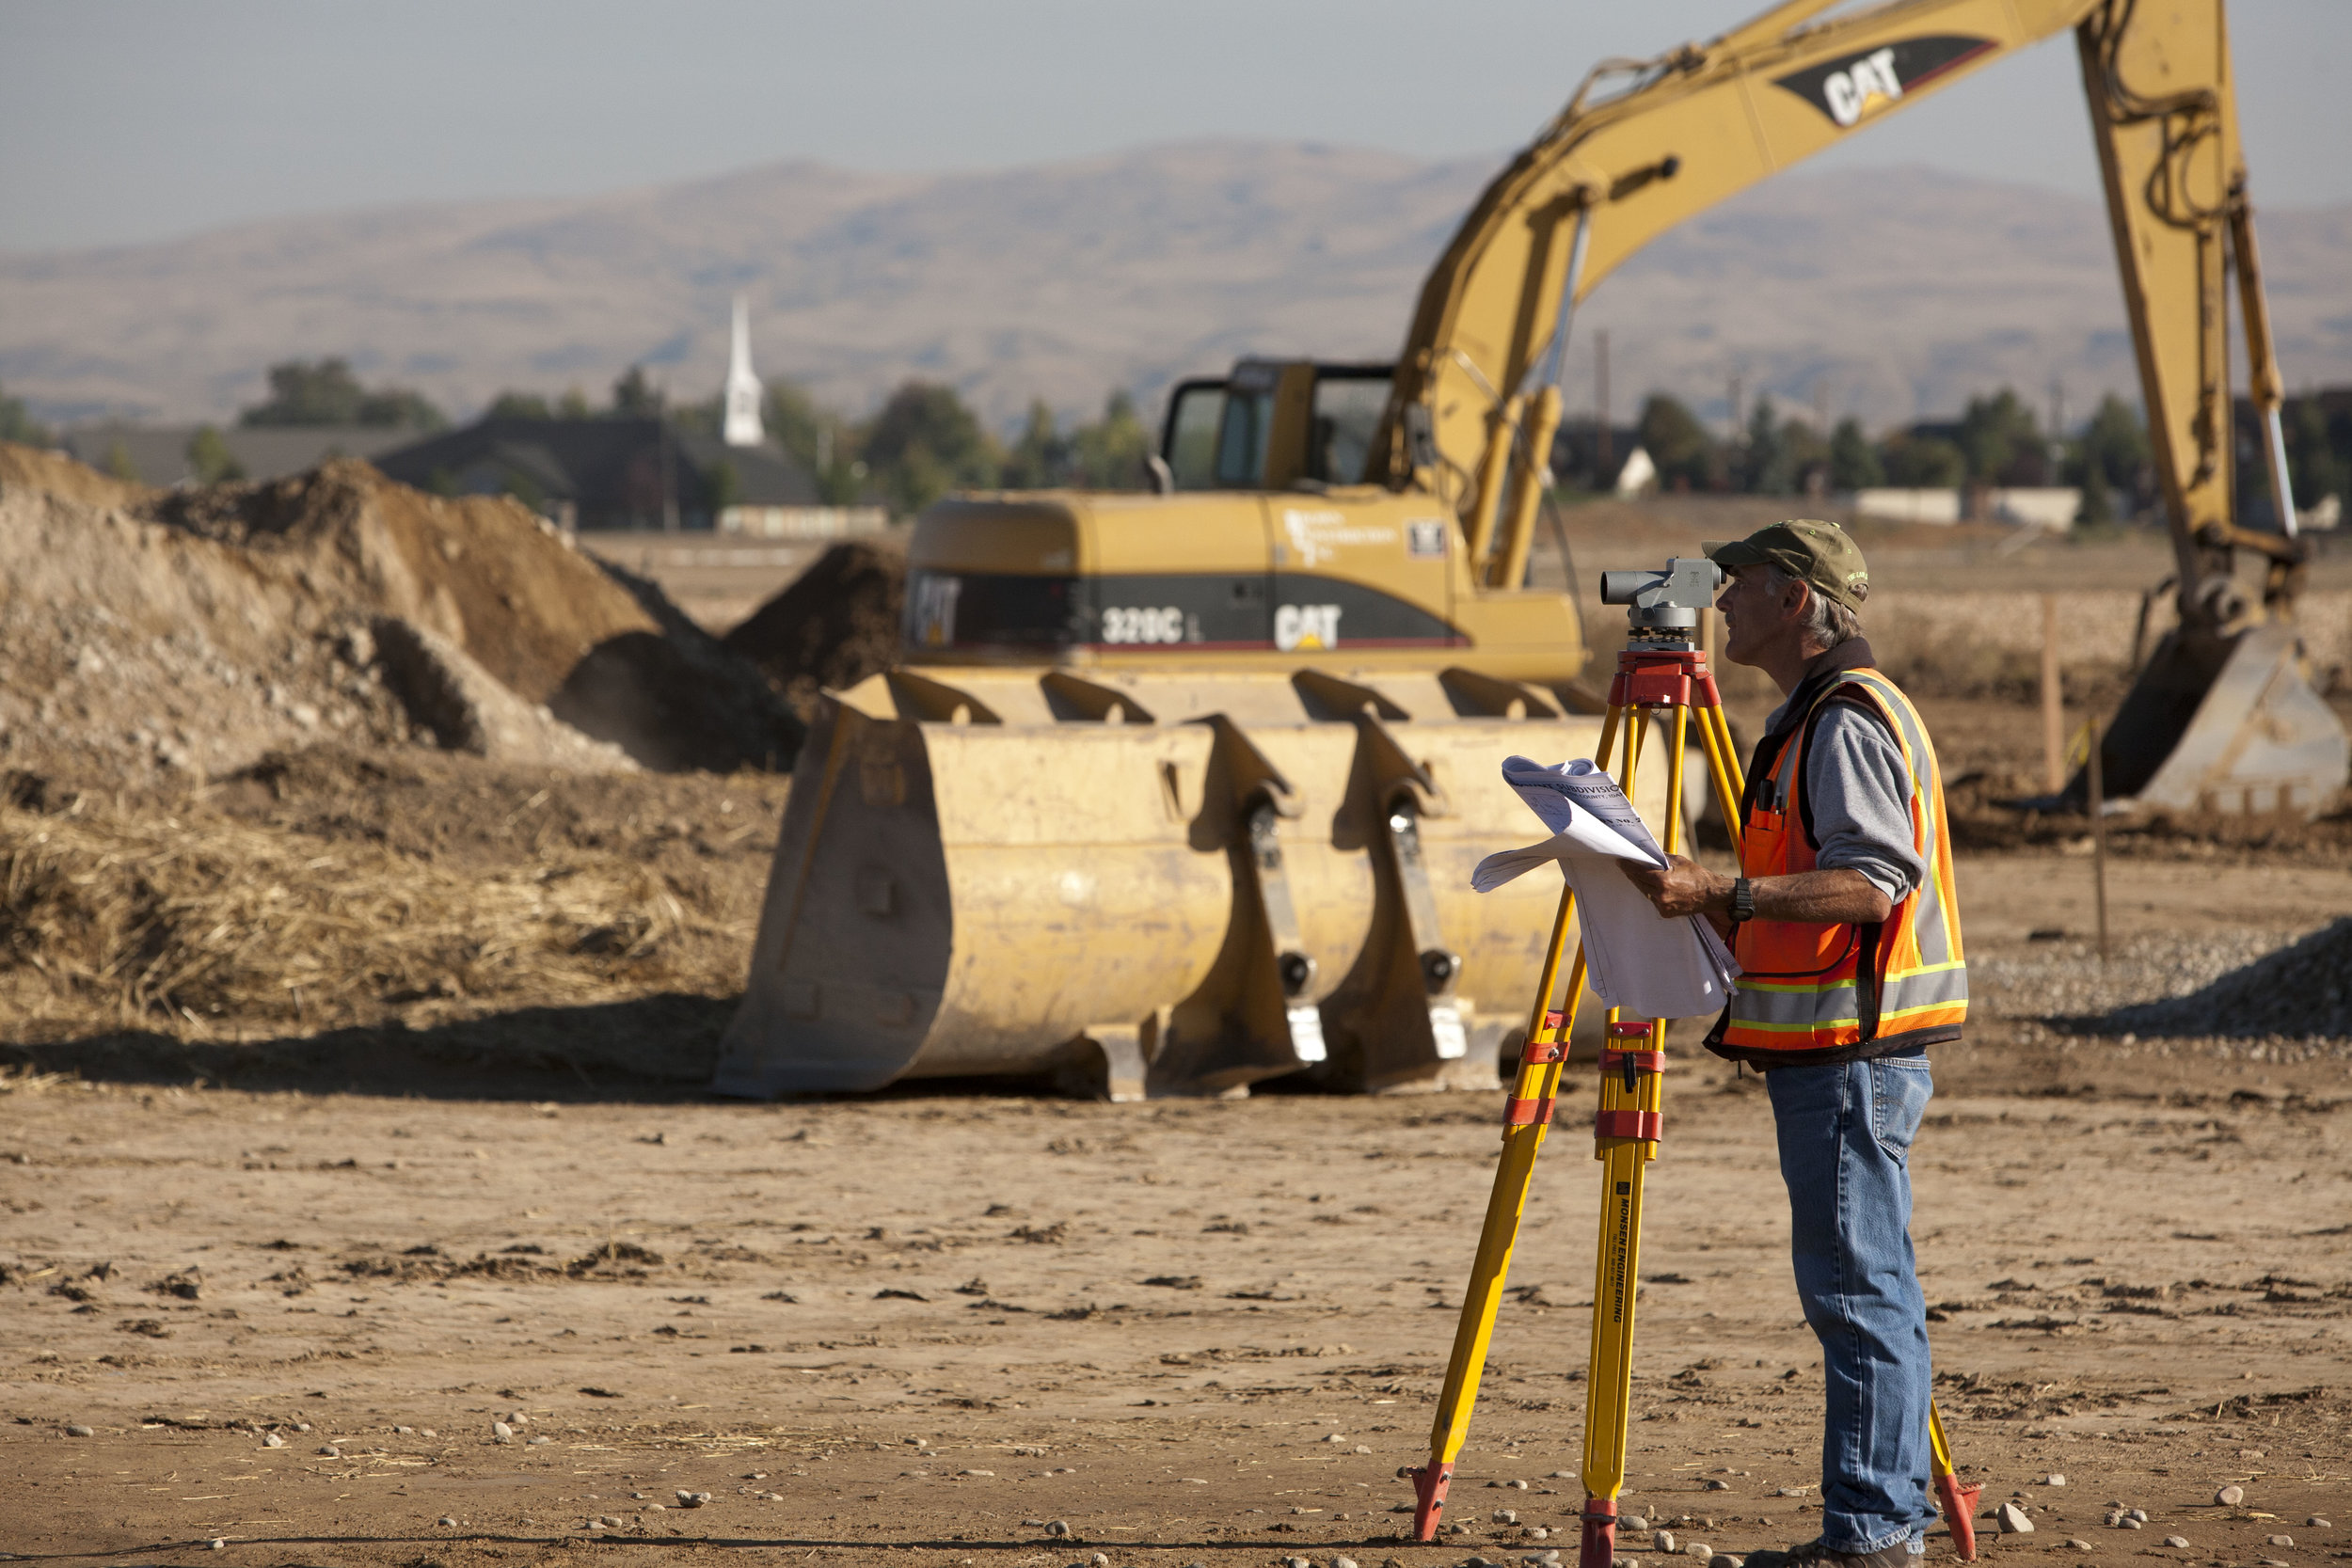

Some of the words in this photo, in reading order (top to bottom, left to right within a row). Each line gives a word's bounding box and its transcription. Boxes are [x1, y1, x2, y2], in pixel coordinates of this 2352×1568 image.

[1823, 47, 1903, 126] CAT
[1275, 604, 1343, 652] CAT
[1618, 1198, 1629, 1245] MONSEN
[1613, 1247, 1626, 1323] ENGINEERING
